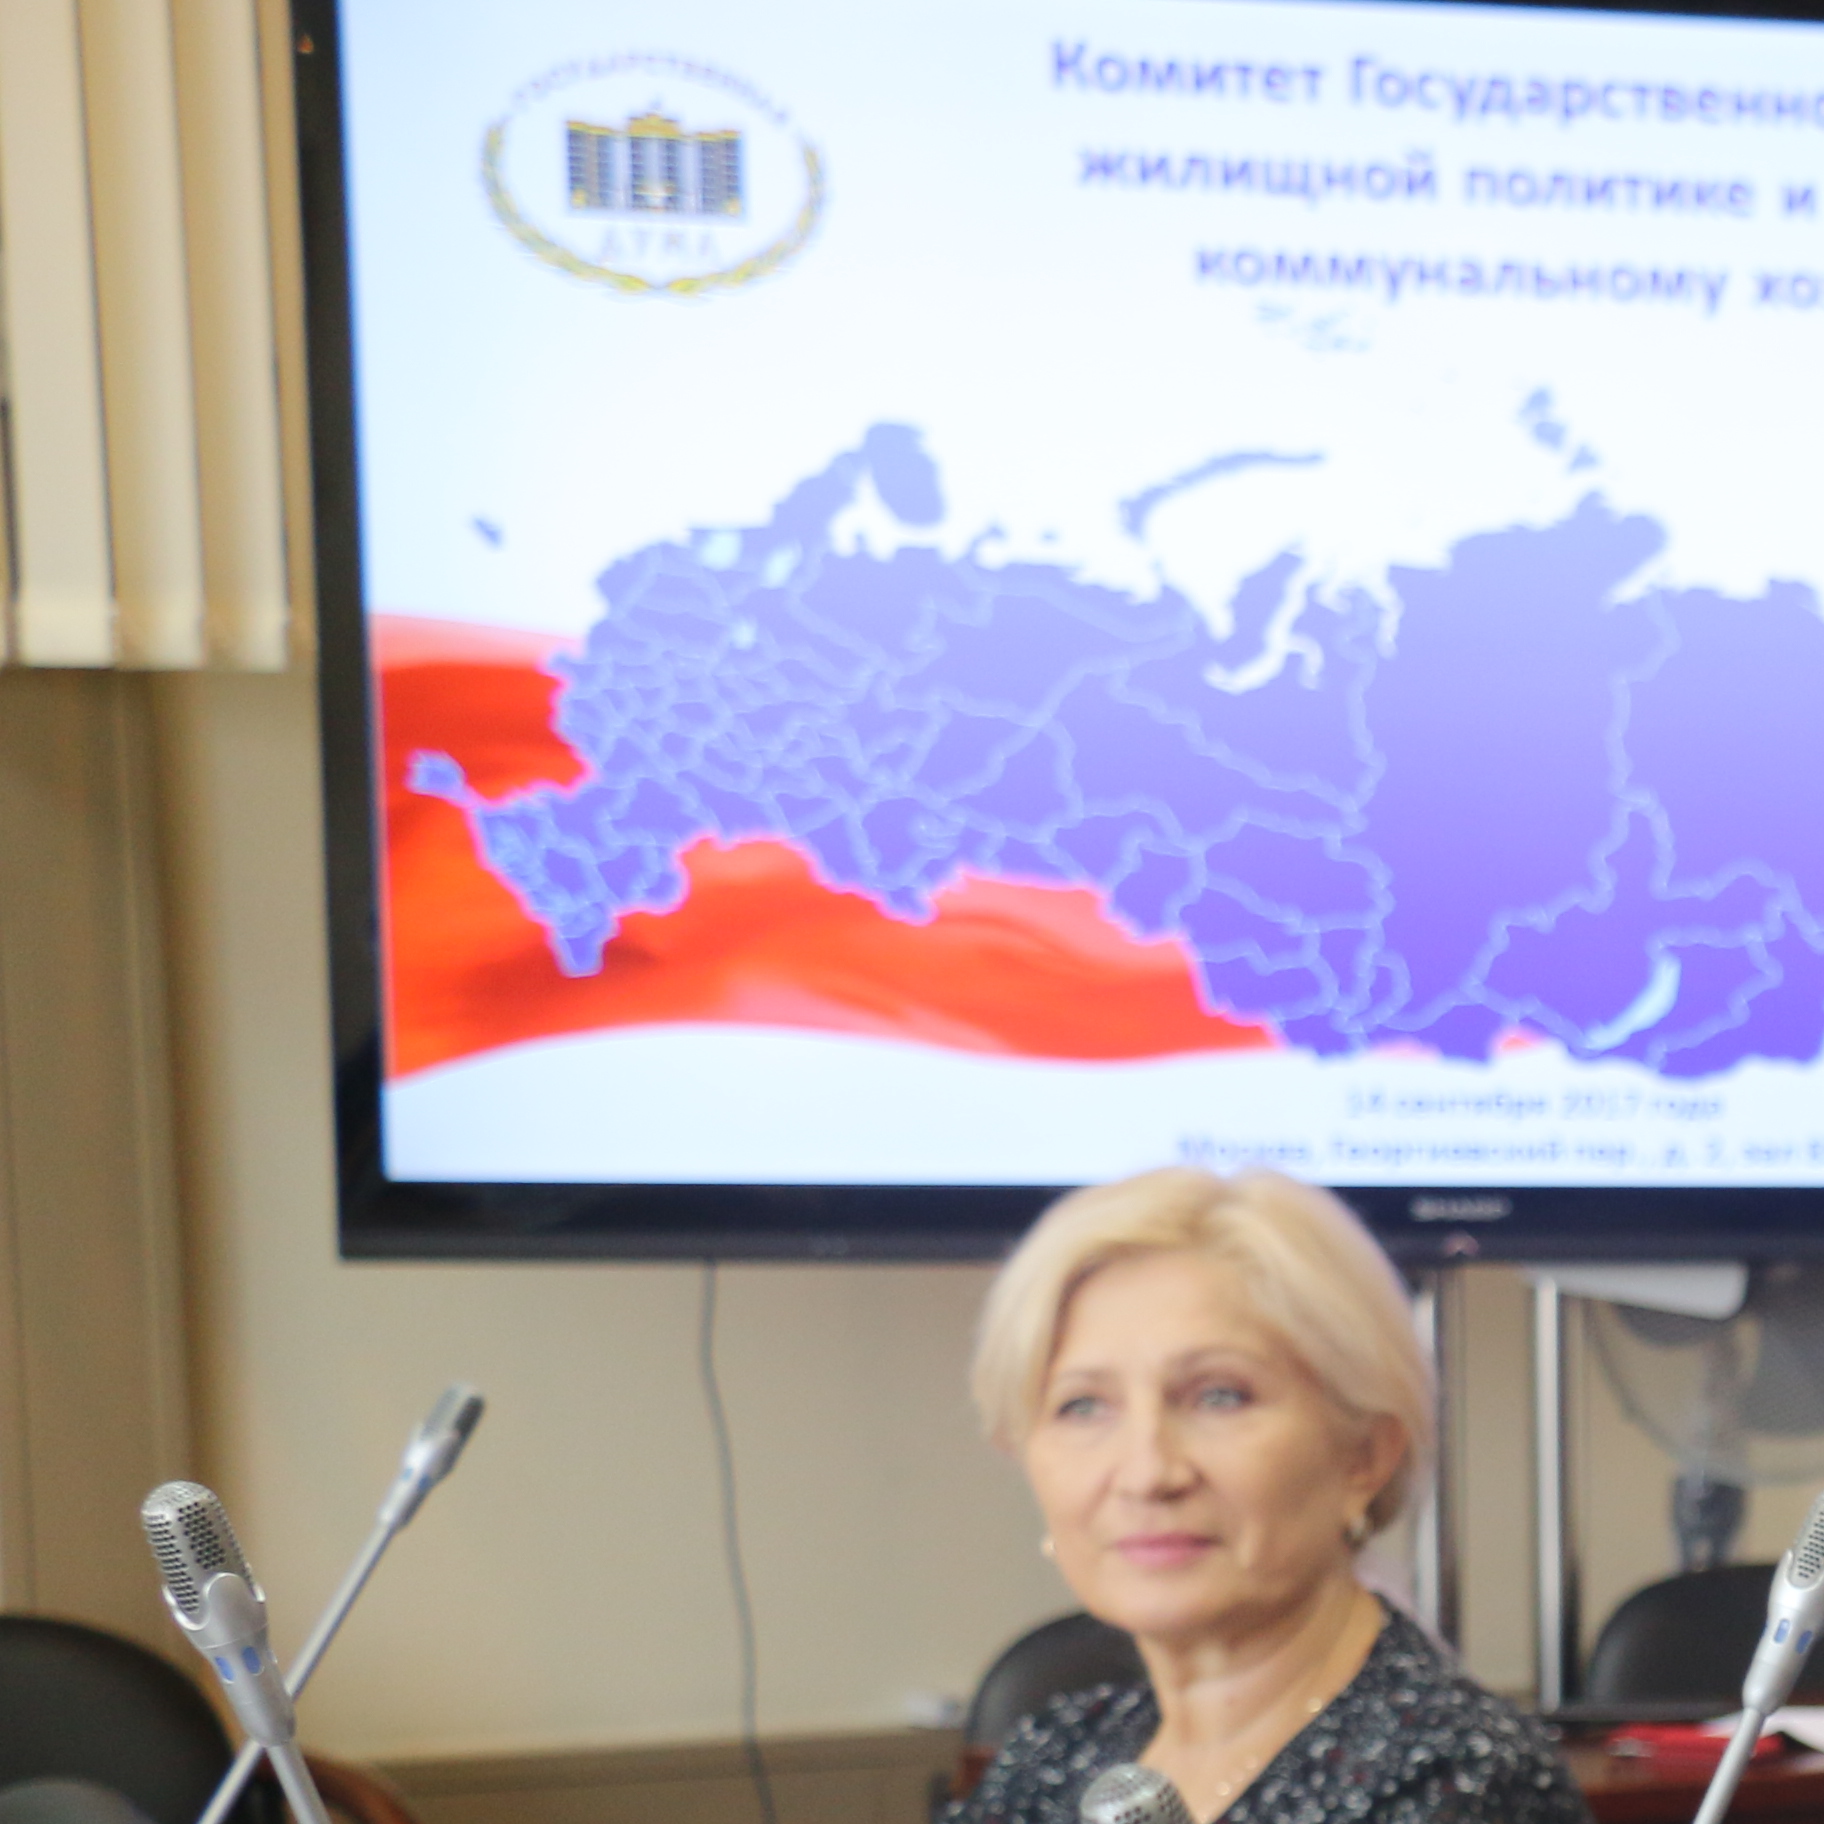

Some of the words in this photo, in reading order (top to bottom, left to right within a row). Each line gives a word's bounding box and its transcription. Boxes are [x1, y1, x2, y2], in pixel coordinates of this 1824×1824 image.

[1051, 39, 1323, 103] Комитет
[1077, 146, 1438, 209] жилищной
[1465, 167, 1755, 220] политике
[1781, 184, 1817, 218] и
[1196, 247, 1730, 318] коммунальному
